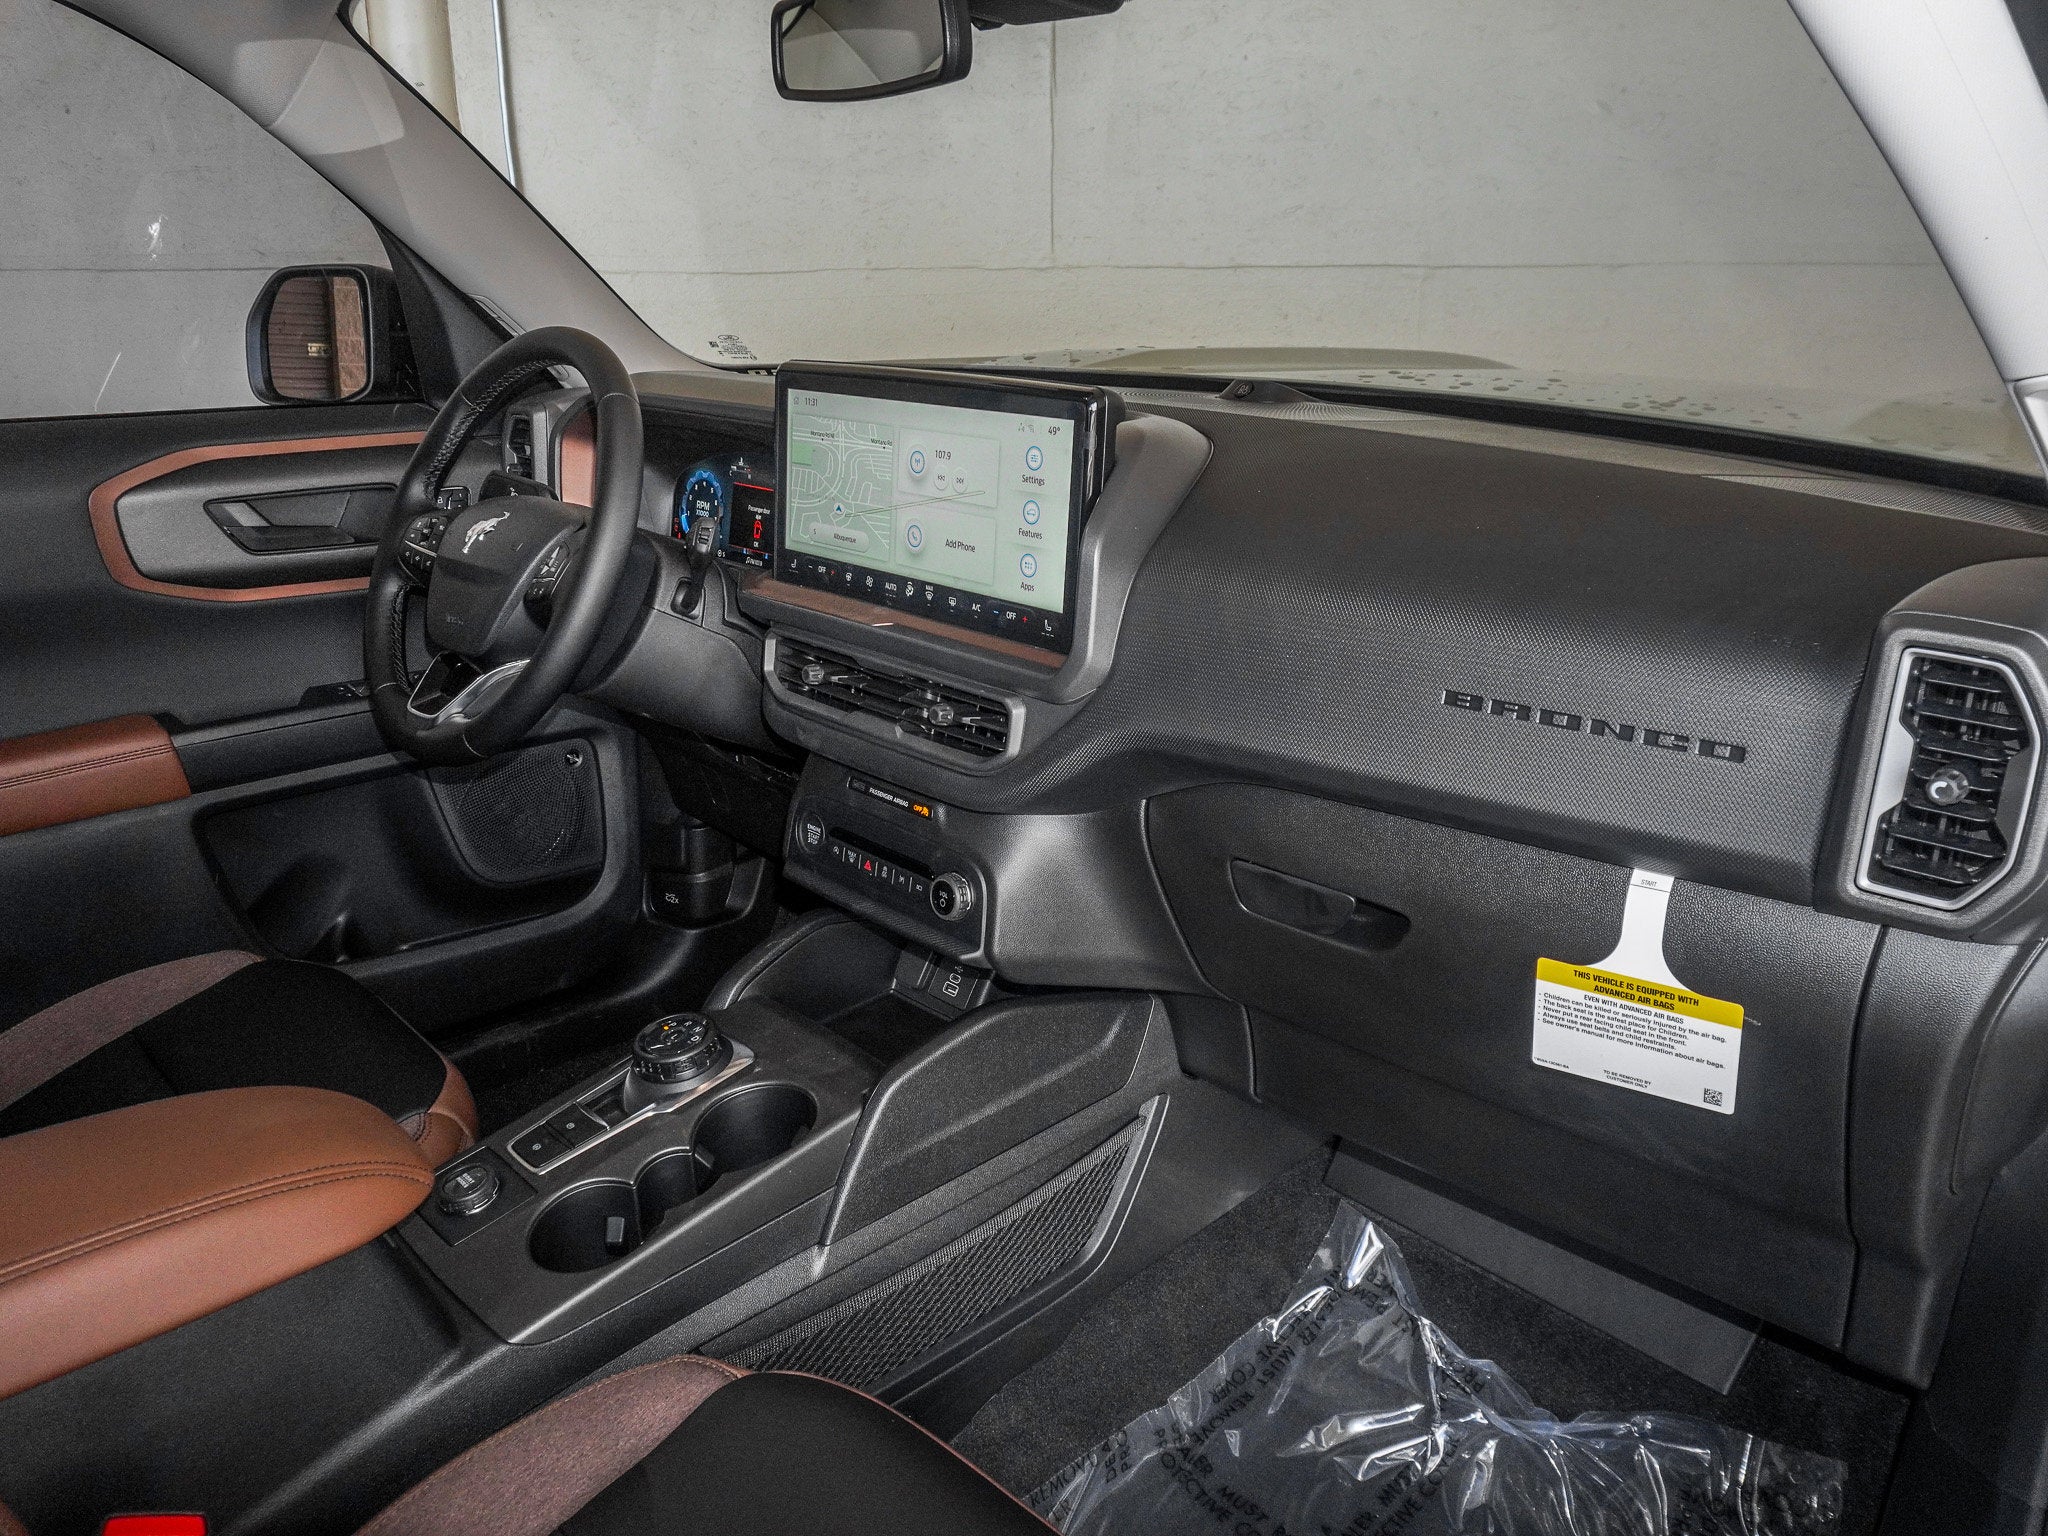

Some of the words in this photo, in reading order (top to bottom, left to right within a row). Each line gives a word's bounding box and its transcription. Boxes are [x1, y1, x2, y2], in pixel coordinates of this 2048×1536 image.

[805, 397, 818, 407] 11:31
[935, 449, 951, 460] 107.9
[1022, 474, 1045, 486] Settings
[696, 500, 710, 511] RPM
[1018, 528, 1043, 540] Features
[945, 539, 957, 550] Add
[958, 541, 976, 553] Phone
[885, 582, 897, 591] AUTO
[1020, 581, 1035, 592] Apps
[972, 603, 981, 612] A/C
[1006, 611, 1017, 620] OFF
[1442, 689, 1746, 764] BRONCO
[869, 787, 894, 801] PASSENGER
[1641, 878, 1658, 888] START
[1574, 970, 1590, 980] THIS
[1593, 974, 1624, 988] VEHICLE
[1626, 982, 1635, 990] IS
[1636, 985, 1676, 1000] EQUIPPED
[1678, 994, 1700, 1006] WITH
[1594, 985, 1636, 1000] ADVANCED
[1638, 996, 1651, 1004] AIR
[1654, 999, 1675, 1010] BAGS
[1584, 994, 1600, 1004] EVEN
[1602, 999, 1618, 1008] WITH
[1618, 1003, 1652, 1016] ADVANCED
[1654, 1012, 1665, 1020] AIR
[1666, 1014, 1684, 1024] BAGS
[1544, 992, 1570, 1004] Children
[1594, 1006, 1612, 1014] killed
[1622, 1012, 1652, 1024] seriously
[1653, 1020, 1676, 1030] injured
[1678, 1026, 1686, 1034] by
[1712, 1034, 1726, 1043] bag.
[1556, 1002, 1572, 1010] back
[1573, 1006, 1586, 1014] seat
[1607, 1015, 1626, 1024] safest
[1628, 1020, 1646, 1029] place
[1658, 1028, 1689, 1040] Children.
[1542, 1006, 1561, 1014] Never
[1562, 1010, 1573, 1018] put
[1594, 1018, 1614, 1028] facing
[1668, 1037, 1686, 1046] front.
[1542, 1012, 1565, 1022] Always
[1594, 1024, 1610, 1033] belts
[1643, 1038, 1676, 1050] restraints.
[1556, 1022, 1580, 1032] owner's
[1581, 1028, 1604, 1038] manual
[1616, 1038, 1633, 1046] more
[1635, 1042, 1674, 1056] information
[1674, 1052, 1694, 1061] about
[1706, 1060, 1726, 1069] bags.
[1606, 1075, 1634, 1086] CUSTOMER
[1619, 1074, 1644, 1083] REMOVED
